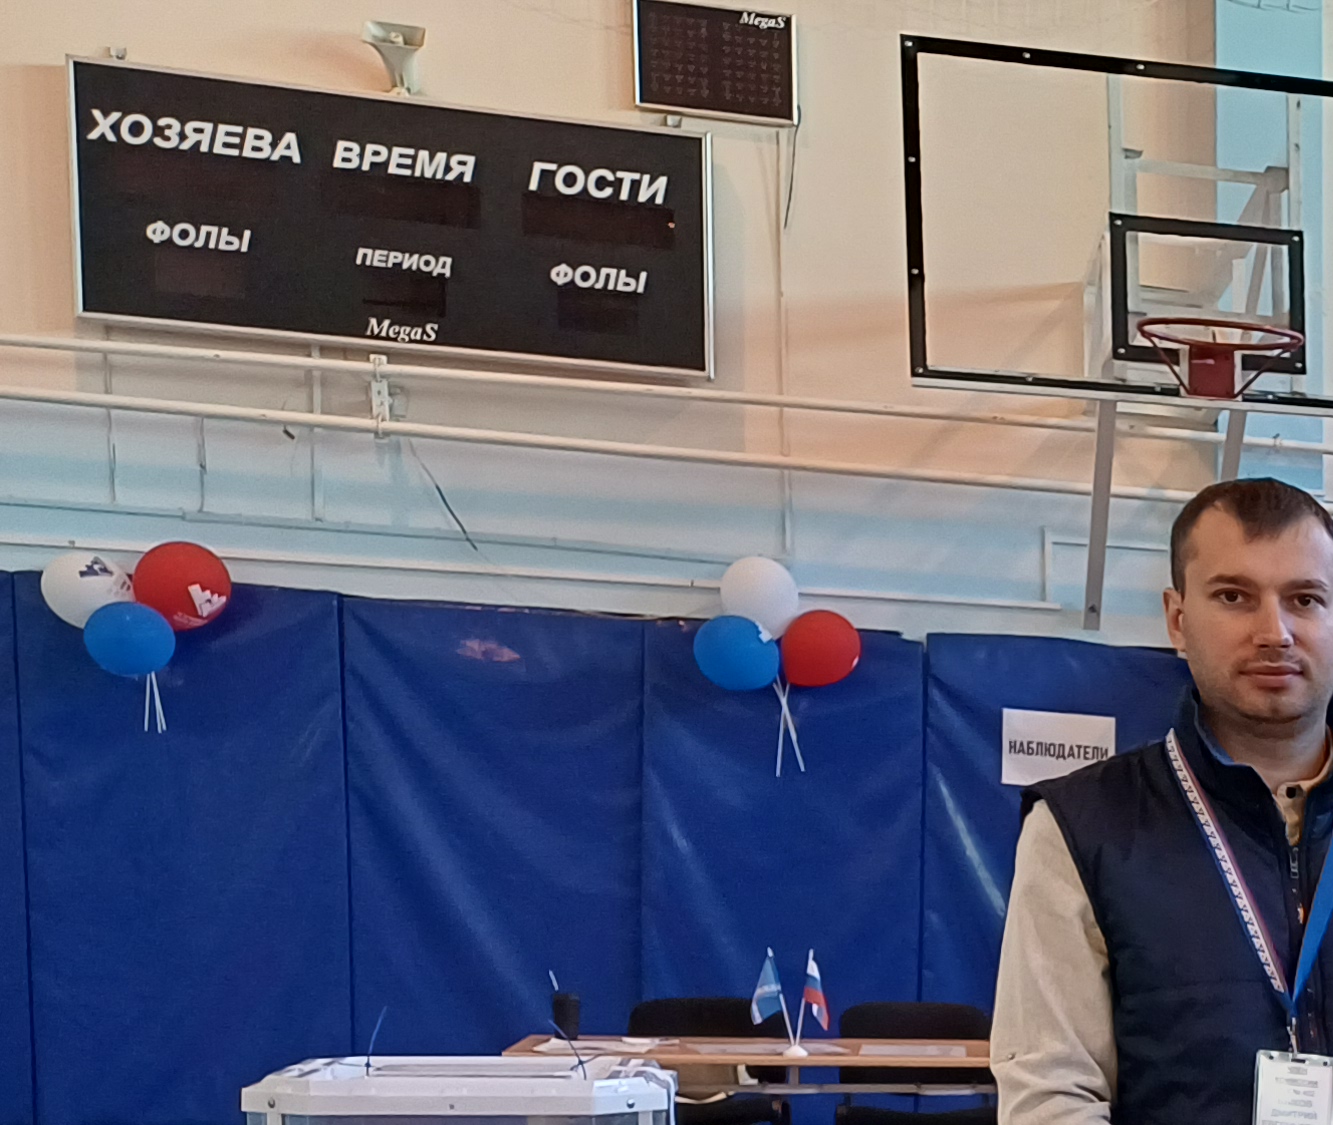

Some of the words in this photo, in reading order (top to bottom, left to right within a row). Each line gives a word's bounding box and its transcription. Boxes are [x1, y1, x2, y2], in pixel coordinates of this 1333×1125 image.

[739, 11, 786, 29] MegaS
[87, 109, 303, 165] ХОЗЯЕВА
[332, 139, 477, 184] ВРЕМЯ
[528, 161, 668, 205] ГОСТИ
[145, 219, 252, 254] ФОЛЫ
[355, 247, 453, 278] ПЕРИОД
[549, 262, 648, 295] ФОЛЫ
[365, 316, 439, 343] MegaS
[1008, 739, 1109, 761] НАБЛЮДАТЕЛИ
